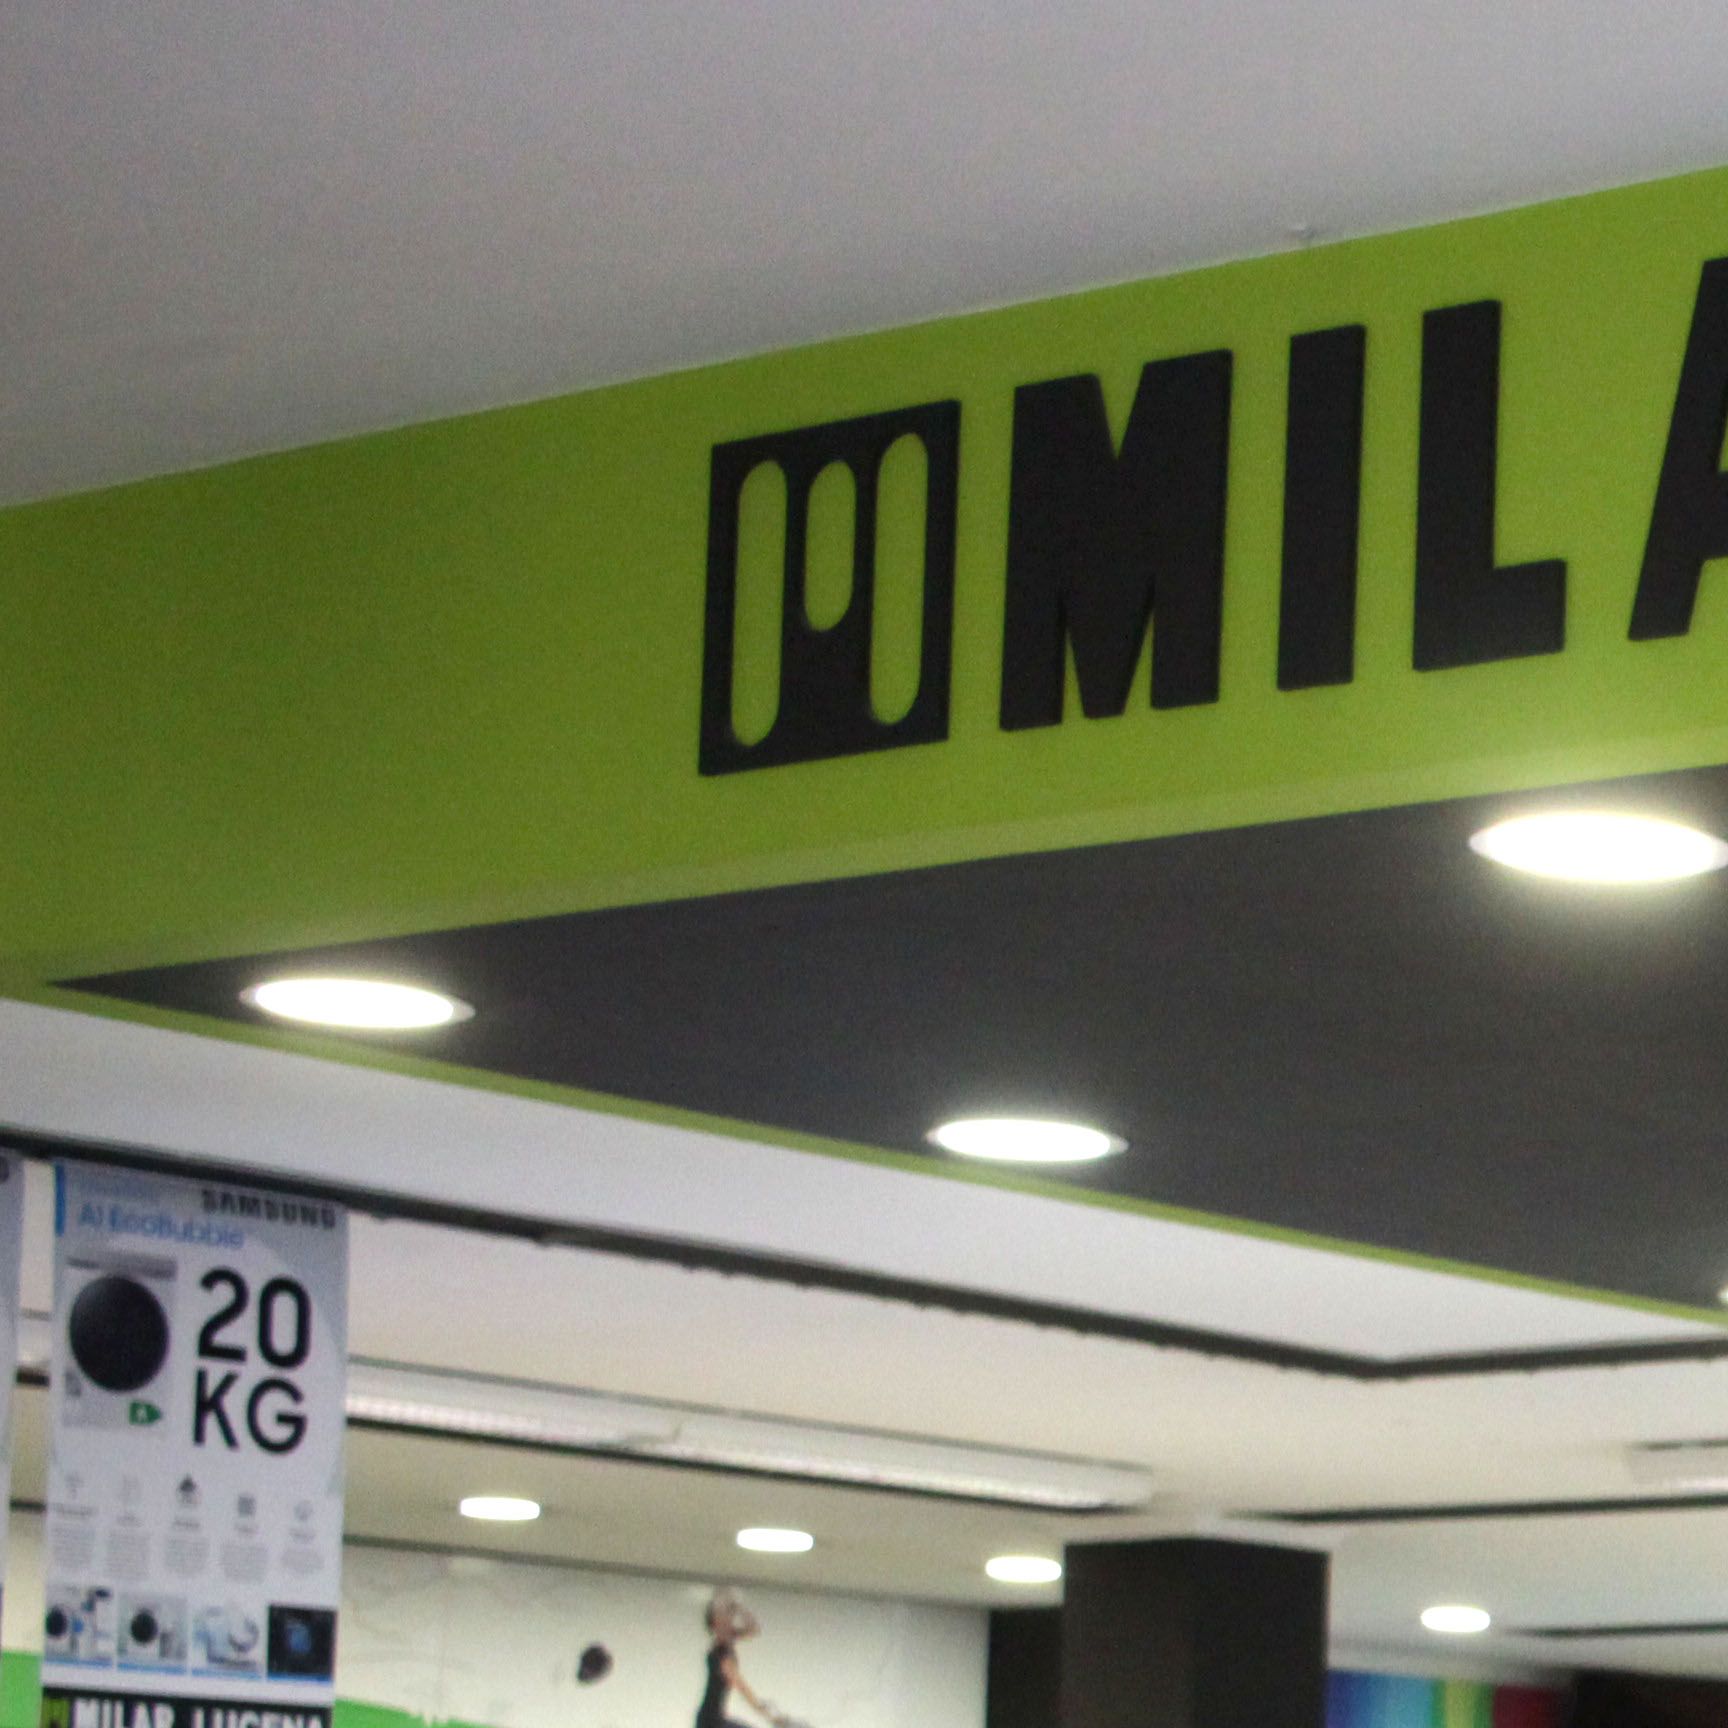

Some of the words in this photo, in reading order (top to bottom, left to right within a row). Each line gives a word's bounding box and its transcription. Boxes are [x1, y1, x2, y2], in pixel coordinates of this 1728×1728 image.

[201, 1188, 336, 1229] SAMSUNG
[197, 1265, 312, 1370] 20
[194, 1367, 308, 1455] KG
